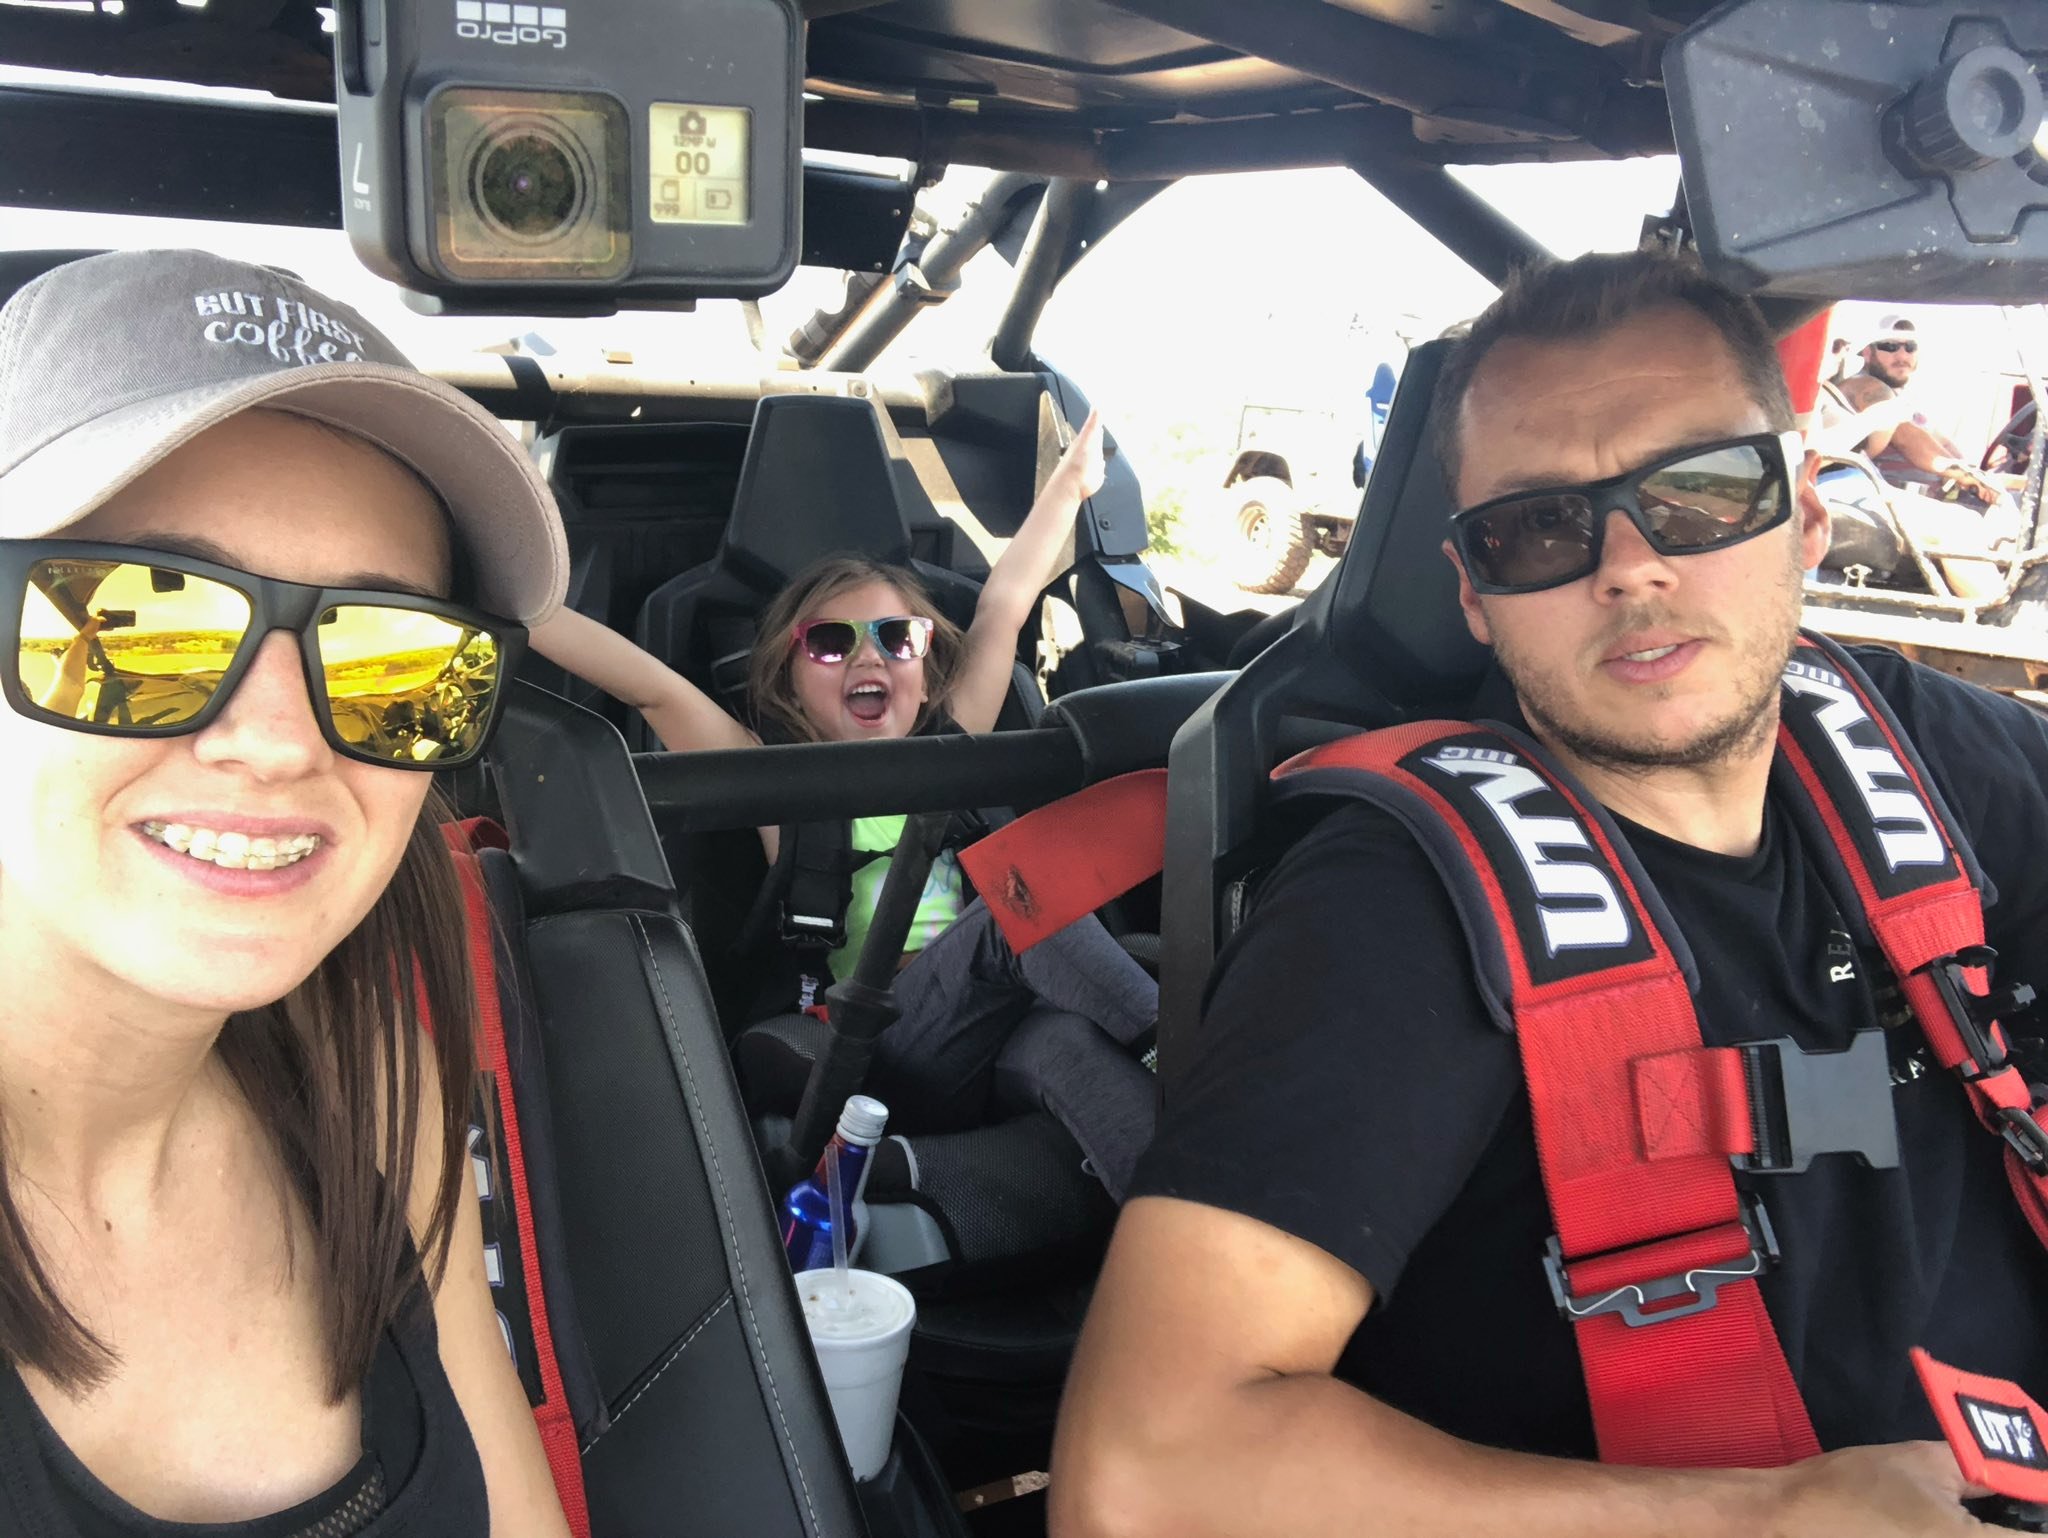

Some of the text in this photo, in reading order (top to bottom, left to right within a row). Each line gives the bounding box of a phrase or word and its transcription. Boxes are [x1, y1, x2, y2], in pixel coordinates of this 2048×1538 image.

[456, 21, 567, 48] GoPro
[195, 291, 365, 353] BUT FIRST
